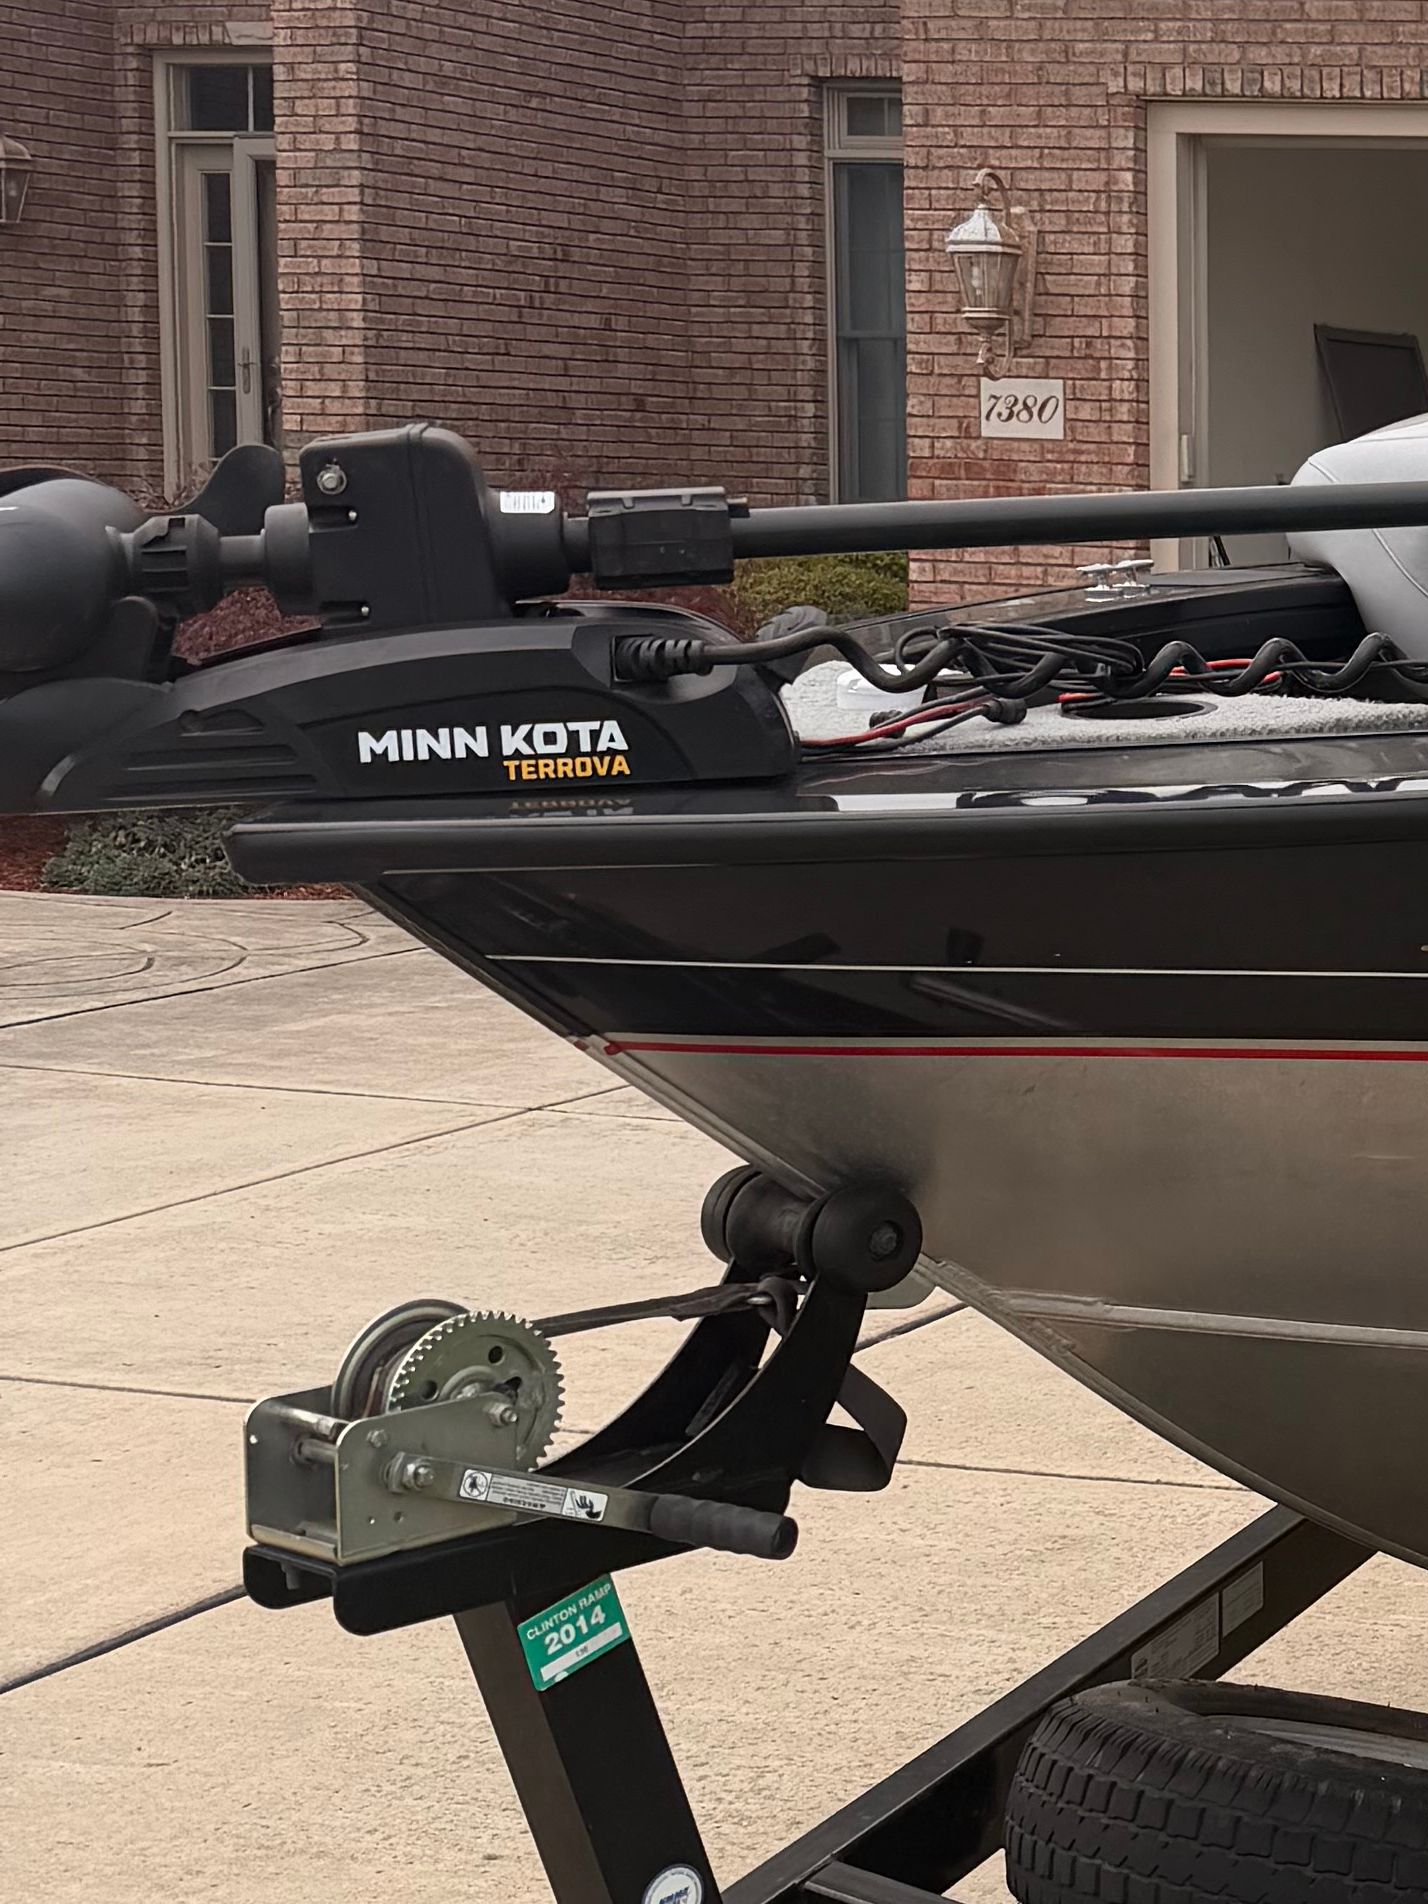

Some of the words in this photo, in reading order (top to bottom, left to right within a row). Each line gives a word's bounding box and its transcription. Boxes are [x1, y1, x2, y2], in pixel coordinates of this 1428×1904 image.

[985, 394, 1060, 424] 7380
[357, 726, 489, 763] MINN
[500, 720, 629, 756] KOTA
[503, 754, 631, 782] TERROVA
[526, 1603, 578, 1641] CLINTON
[579, 1582, 612, 1610] RAMP
[544, 1604, 606, 1656] 2014
